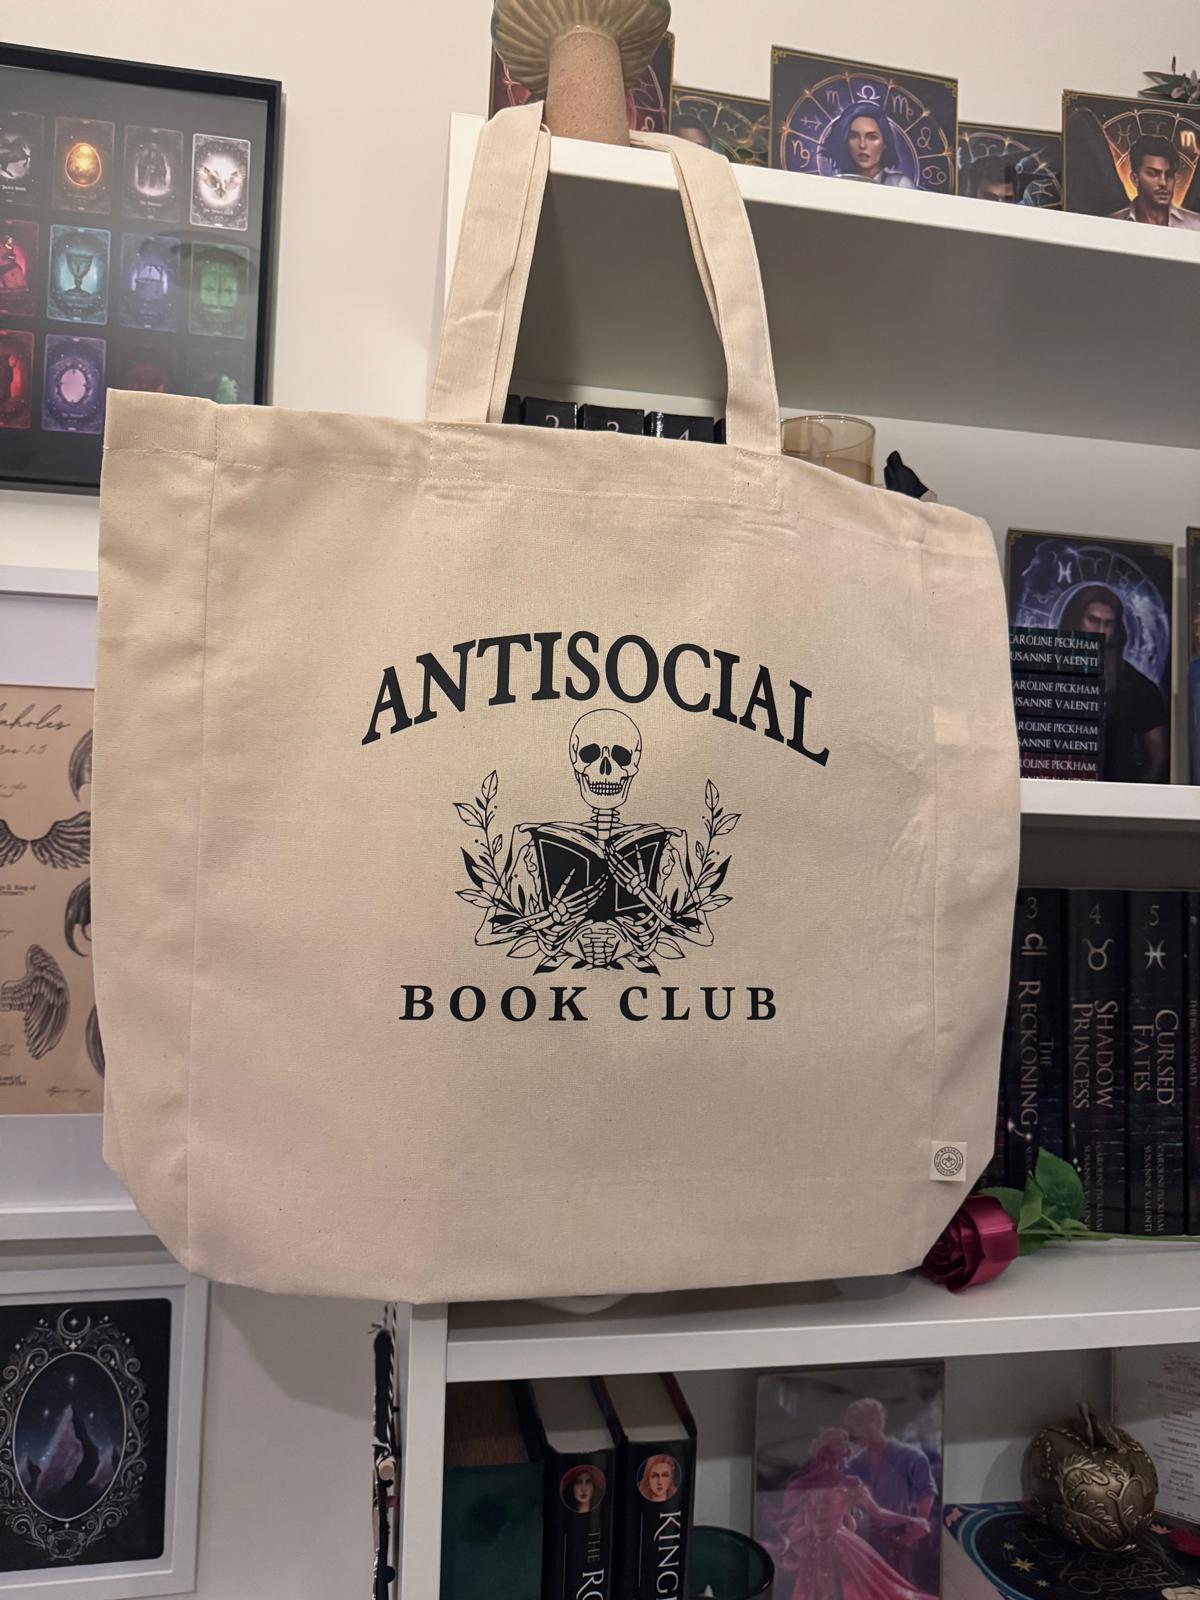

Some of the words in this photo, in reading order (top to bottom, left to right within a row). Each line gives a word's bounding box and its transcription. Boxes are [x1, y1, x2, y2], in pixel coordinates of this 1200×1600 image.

[1054, 637, 1099, 650] PECKHAM
[1010, 651, 1053, 663] USANNE
[1055, 654, 1098, 667] VALENTI
[361, 630, 831, 768] ANTISOCIAL
[1012, 681, 1054, 693] AROLINE
[1055, 682, 1100, 695] PECKHAM
[1014, 696, 1053, 709] SANNE
[1055, 700, 1099, 712] VALENTI
[1017, 721, 1053, 732] ROLINE
[1053, 722, 1099, 735] PECKHAM
[1054, 739, 1098, 751] VALENTI
[1051, 760, 1096, 771] PECKHAM
[1027, 896, 1038, 919] 3
[1089, 904, 1101, 925] 4
[1149, 905, 1160, 926] 5
[399, 985, 589, 1022] BOOK
[620, 985, 777, 1022] CLUB
[1018, 981, 1040, 1126] RECKONING
[1040, 1040, 1055, 1066] THE
[1072, 1003, 1094, 1110] PRINCESS
[1094, 1000, 1119, 1109] SHADOW
[1132, 1025, 1154, 1092] FATES
[1155, 1009, 1179, 1105] CURSED
[587, 1530, 601, 1564] THE
[653, 1510, 682, 1600] KING
